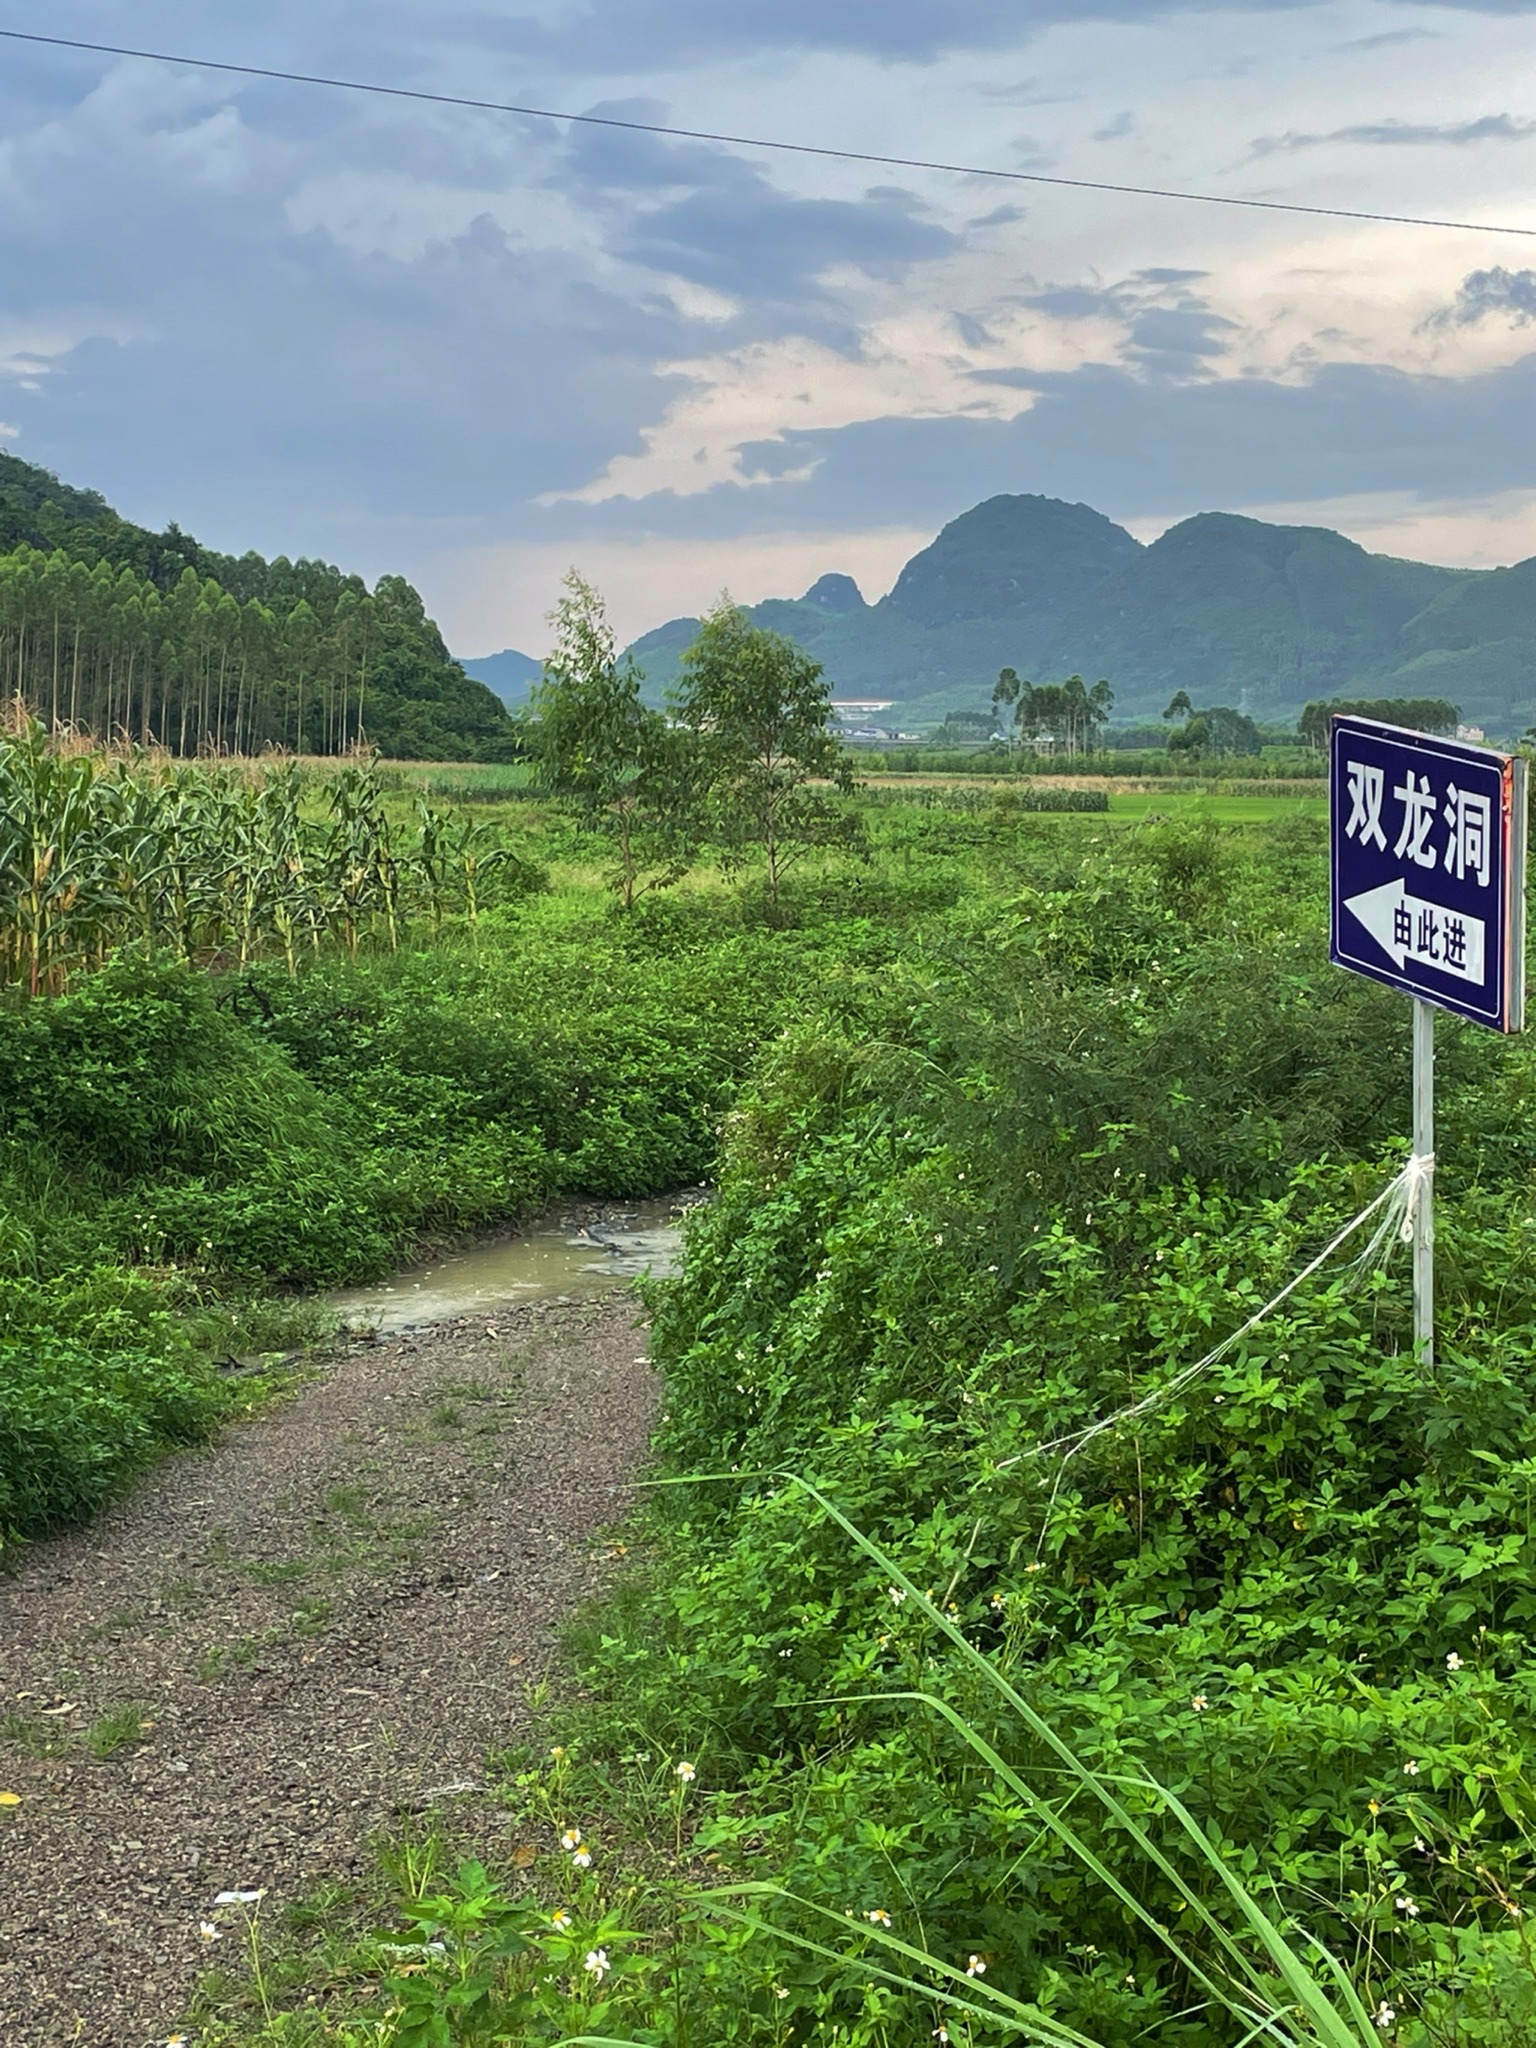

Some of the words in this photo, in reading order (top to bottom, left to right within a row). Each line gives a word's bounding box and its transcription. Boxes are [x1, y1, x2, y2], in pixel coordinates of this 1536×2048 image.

[1345, 761, 1491, 887] 双龙洞
[1394, 900, 1466, 971] 由此进
